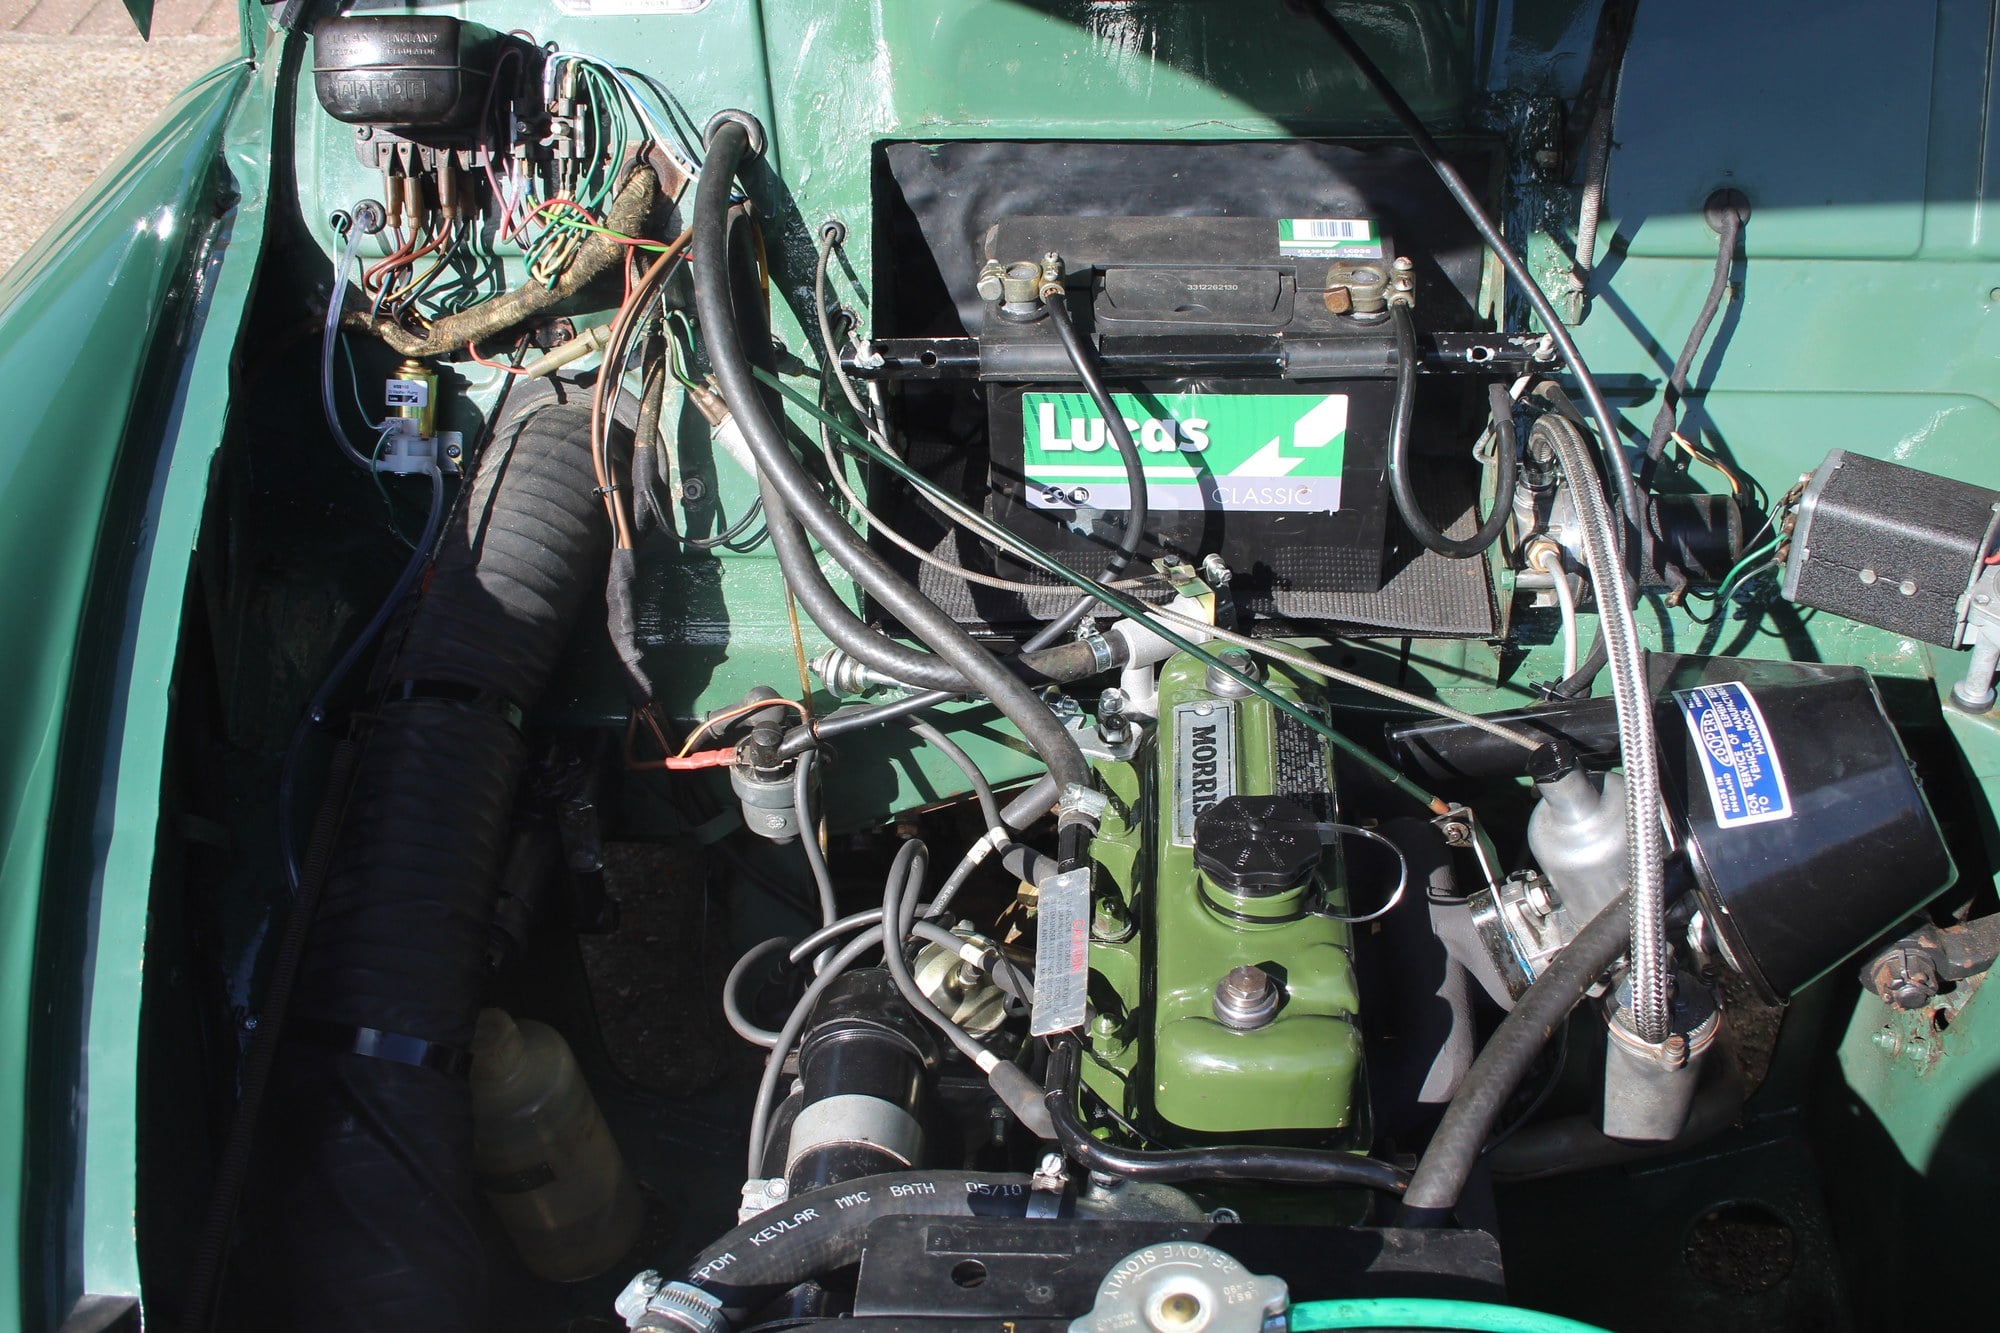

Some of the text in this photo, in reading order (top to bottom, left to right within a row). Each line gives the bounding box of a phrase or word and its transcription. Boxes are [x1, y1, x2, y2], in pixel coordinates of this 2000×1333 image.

[384, 32, 438, 45] ENGLAND
[1038, 402, 1210, 453] Lucas
[1211, 487, 1314, 505] CLASSIC
[1714, 701, 1734, 728] ELEMENT
[1704, 712, 1730, 764] COOPERS
[1727, 733, 1740, 745] OF
[1192, 724, 1218, 817] MORRIS
[1734, 750, 1755, 788] SERVICE
[1742, 741, 1762, 781] VEHICLE
[1716, 776, 1732, 812] MADE IN
[1723, 772, 1741, 813] ENGLAND
[1747, 793, 1761, 815] FOR
[1759, 796, 1771, 814] TO
[1071, 918, 1085, 974] CAUTION
[689, 1182, 1022, 1286] EPDM KEVLAR MMC BATH 05/10
[1104, 1245, 1237, 1300] REMOVE SLOWLY
